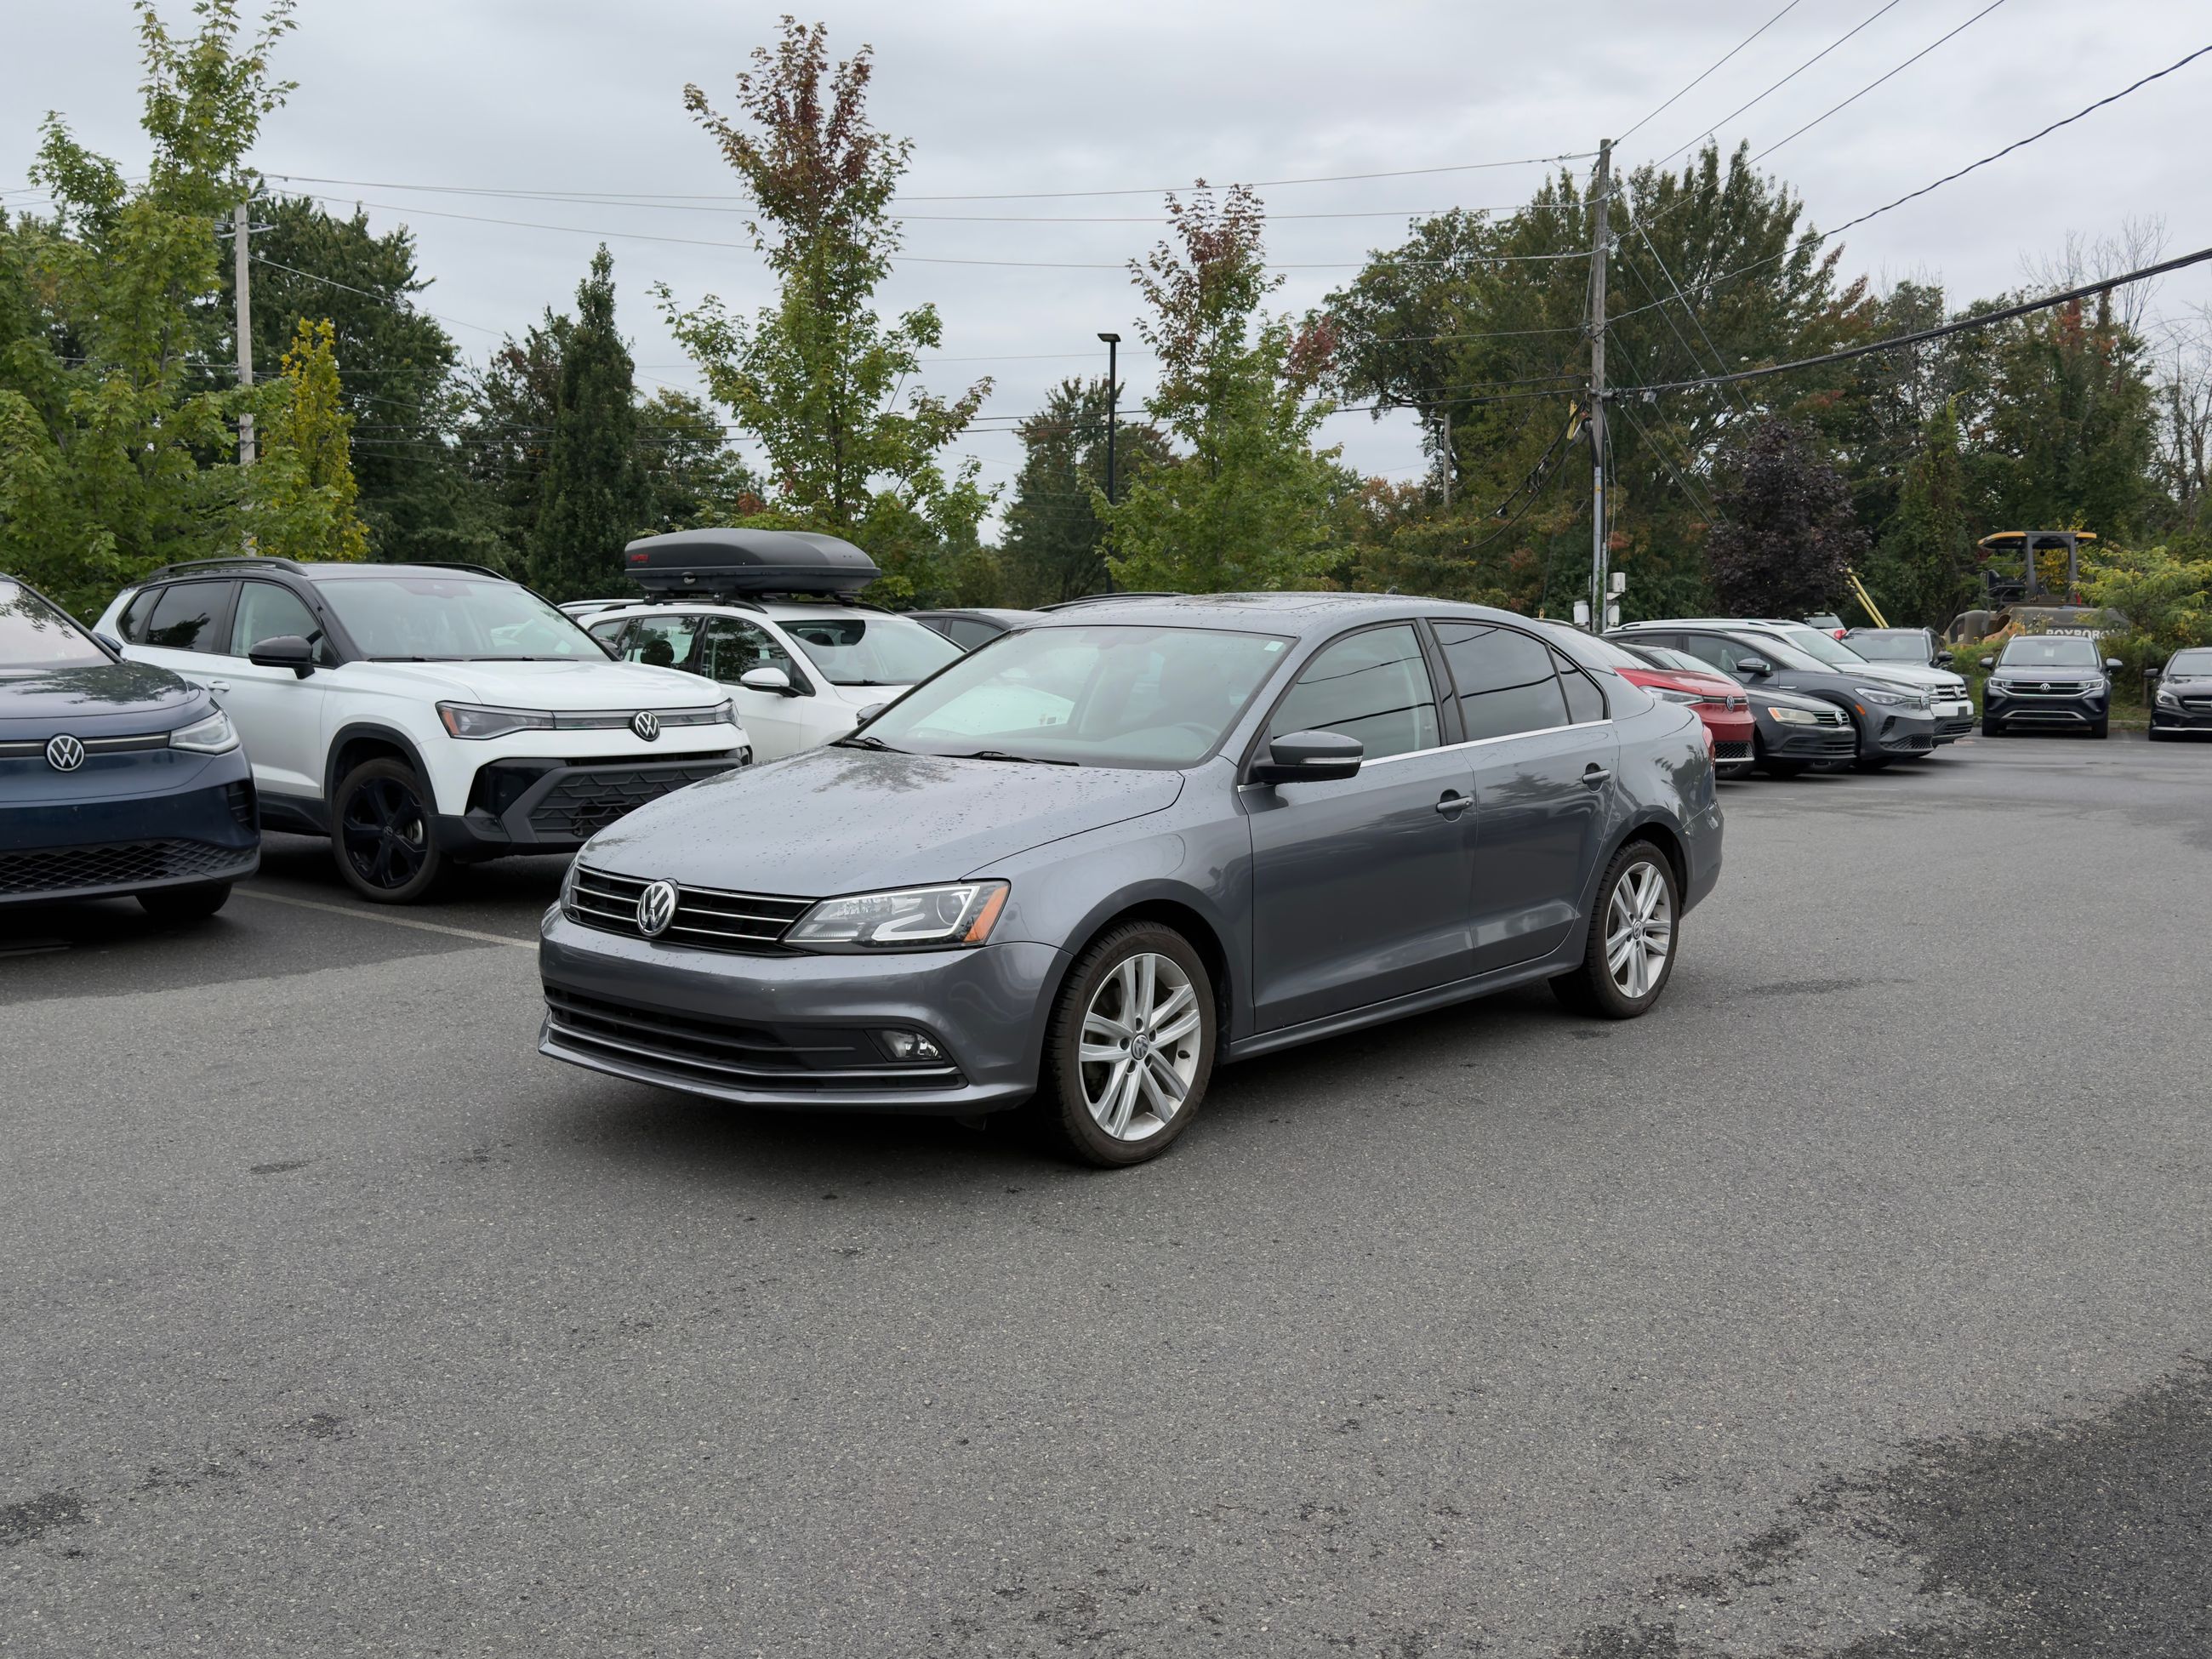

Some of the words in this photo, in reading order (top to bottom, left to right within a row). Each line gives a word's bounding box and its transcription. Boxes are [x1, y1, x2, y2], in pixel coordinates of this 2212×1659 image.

[636, 711, 660, 740] VW
[47, 736, 84, 771] VW
[637, 881, 676, 936] VW
